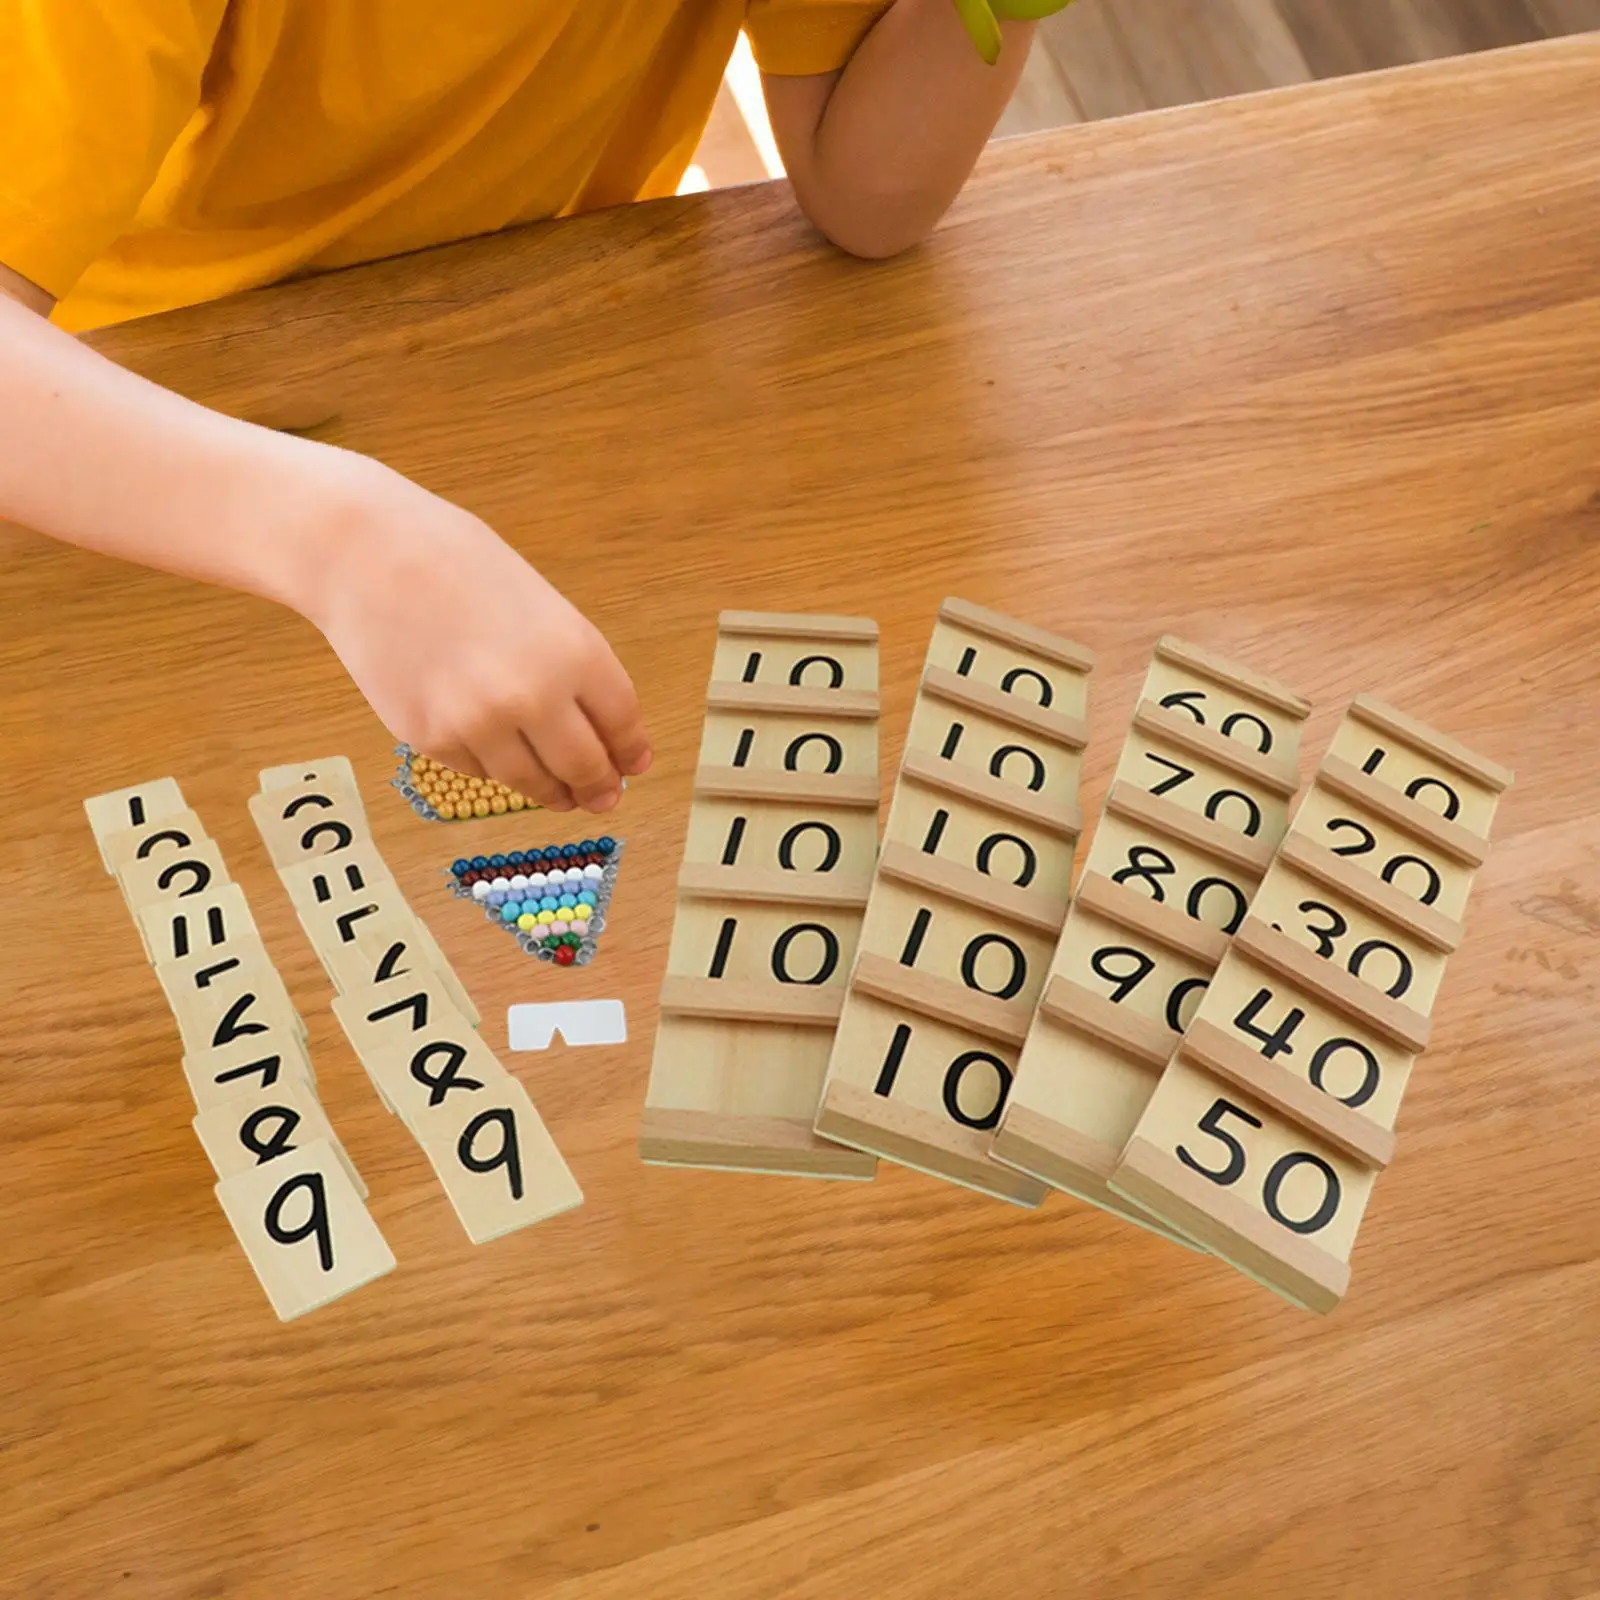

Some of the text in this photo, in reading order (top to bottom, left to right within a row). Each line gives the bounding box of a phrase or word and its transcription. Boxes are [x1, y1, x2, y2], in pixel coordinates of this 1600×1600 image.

[742, 652, 845, 689] 10
[733, 728, 844, 774] 10
[940, 721, 1046, 793] 10
[1145, 752, 1262, 839] 70
[721, 815, 842, 874] 10
[922, 808, 1037, 889] 10
[1111, 846, 1248, 937] 80
[708, 918, 840, 986] 10
[899, 907, 1028, 1002] 10
[1091, 945, 1213, 1036] 90
[874, 1024, 1015, 1131] 10
[1233, 987, 1381, 1109] 40
[457, 1108, 523, 1200] 9
[1175, 1097, 1341, 1235] 50
[264, 1172, 334, 1272] 9
